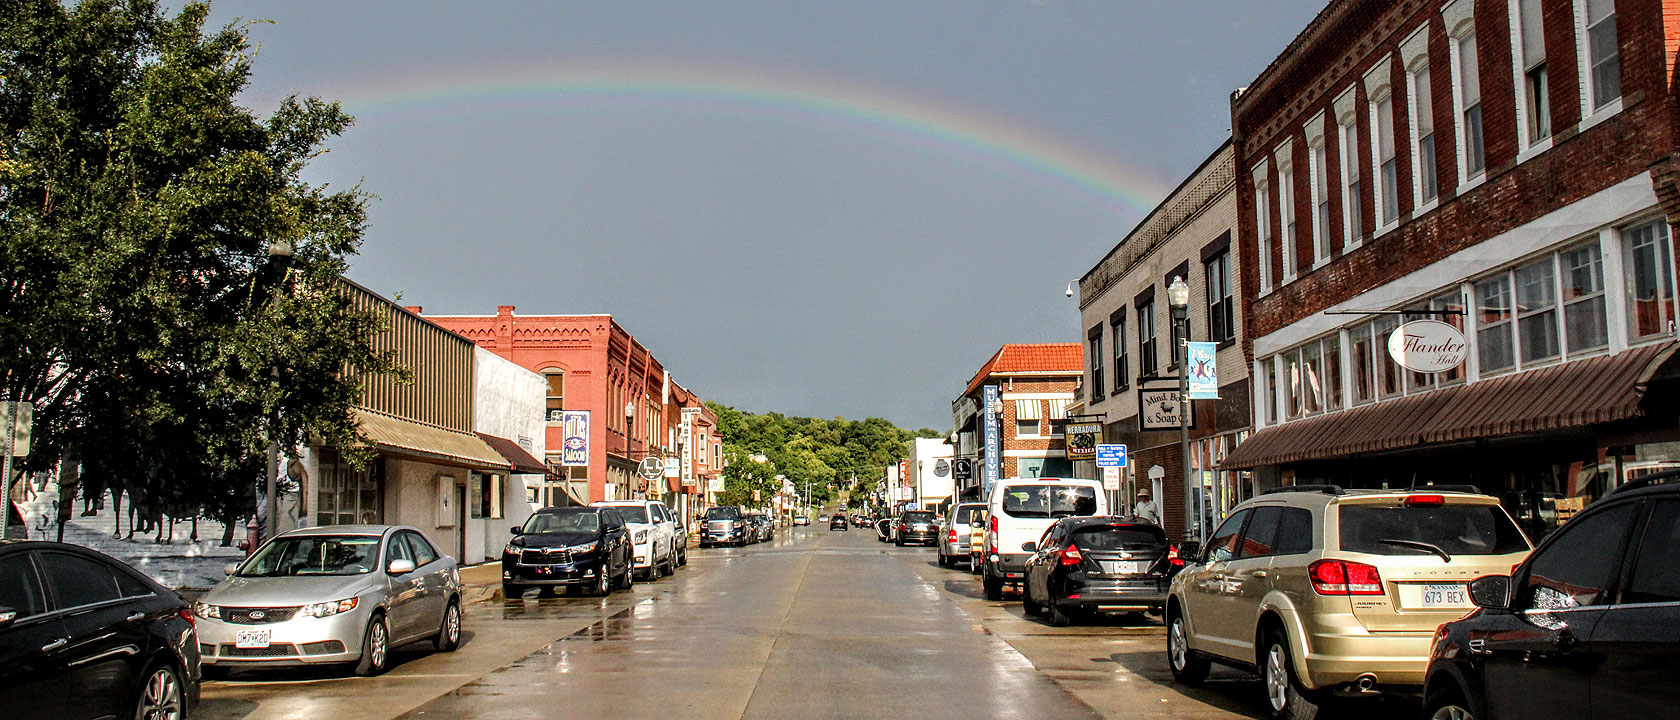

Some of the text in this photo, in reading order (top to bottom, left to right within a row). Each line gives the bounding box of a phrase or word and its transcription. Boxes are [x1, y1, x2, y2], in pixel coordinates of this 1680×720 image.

[1403, 334, 1464, 352] Flander
[1192, 349, 1213, 359] Play
[1436, 354, 1459, 365] Hall
[1170, 393, 1181, 402] Bo
[986, 388, 996, 427] MUSEUM
[1147, 415, 1154, 424] &
[1155, 412, 1177, 425] Soap
[1067, 424, 1101, 434] HERRADURA
[565, 448, 586, 462] SALOON
[987, 432, 996, 483] ARCHIVES
[1424, 591, 1465, 603] 673 BEX
